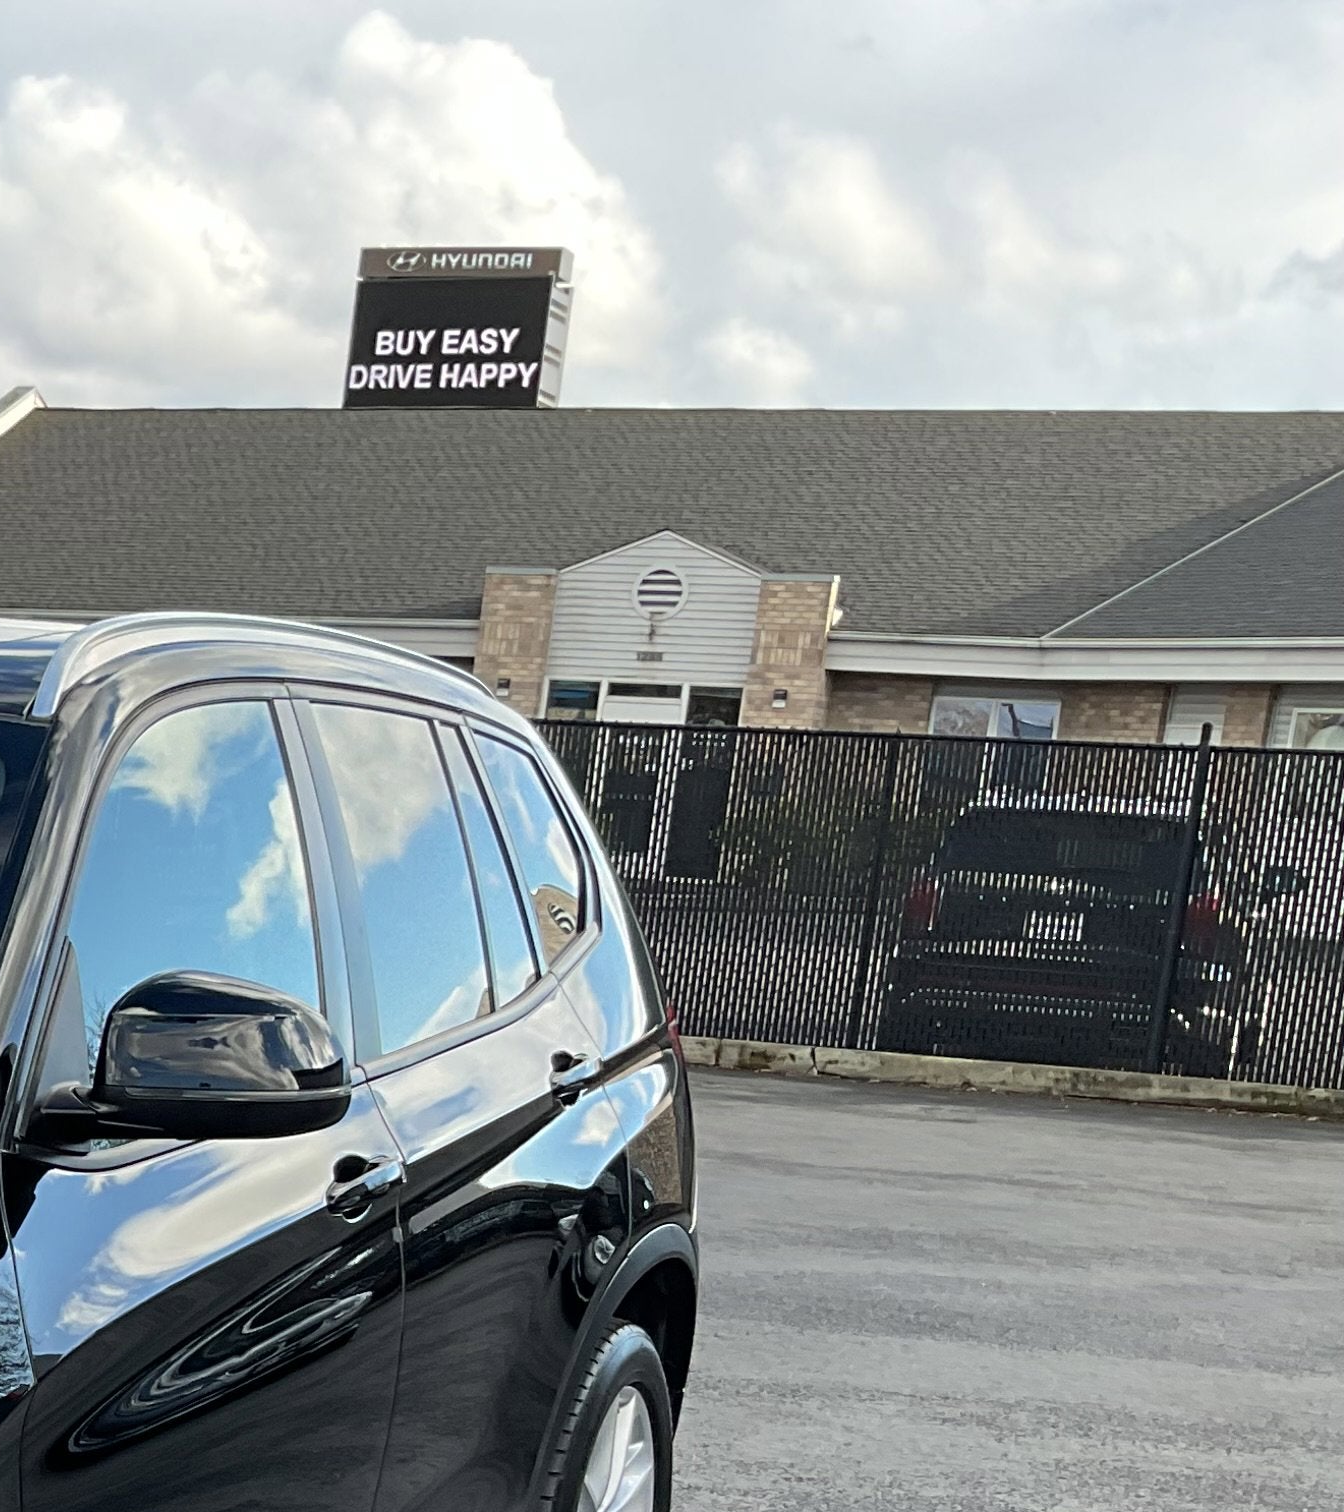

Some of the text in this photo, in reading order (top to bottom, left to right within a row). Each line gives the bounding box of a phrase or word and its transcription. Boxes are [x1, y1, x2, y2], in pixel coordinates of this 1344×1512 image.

[431, 252, 533, 270] HYUNDAI
[374, 328, 520, 356] BUY EASY
[348, 362, 538, 389] DRIVE HAPPY
